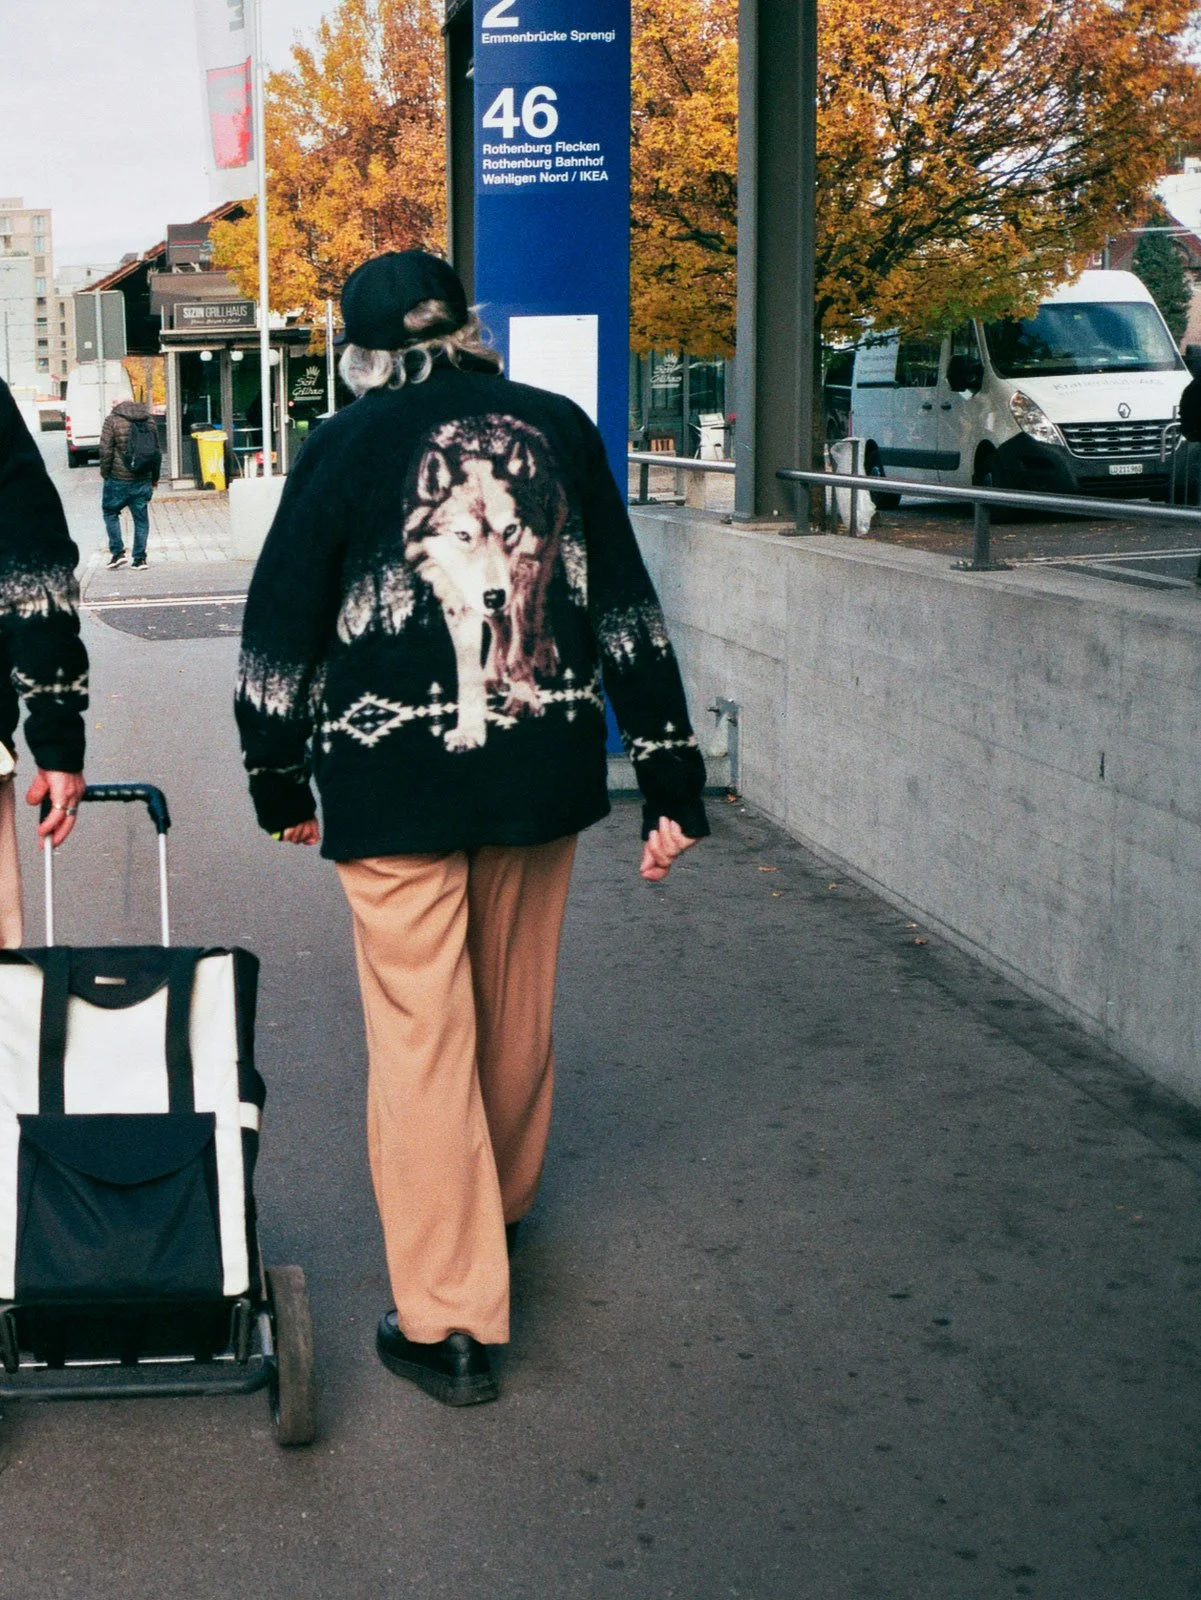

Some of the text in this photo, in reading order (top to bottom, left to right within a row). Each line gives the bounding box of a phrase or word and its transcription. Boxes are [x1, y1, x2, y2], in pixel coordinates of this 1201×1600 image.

[481, 0, 519, 28] 2
[481, 29, 616, 44] Emmenbrücke Sprengi
[482, 85, 559, 139] 46
[482, 141, 600, 155] Rothenburg Flecken
[482, 156, 604, 170] Rothenburg Bahnhof
[482, 171, 609, 185] Wahligen Nord / IKEA
